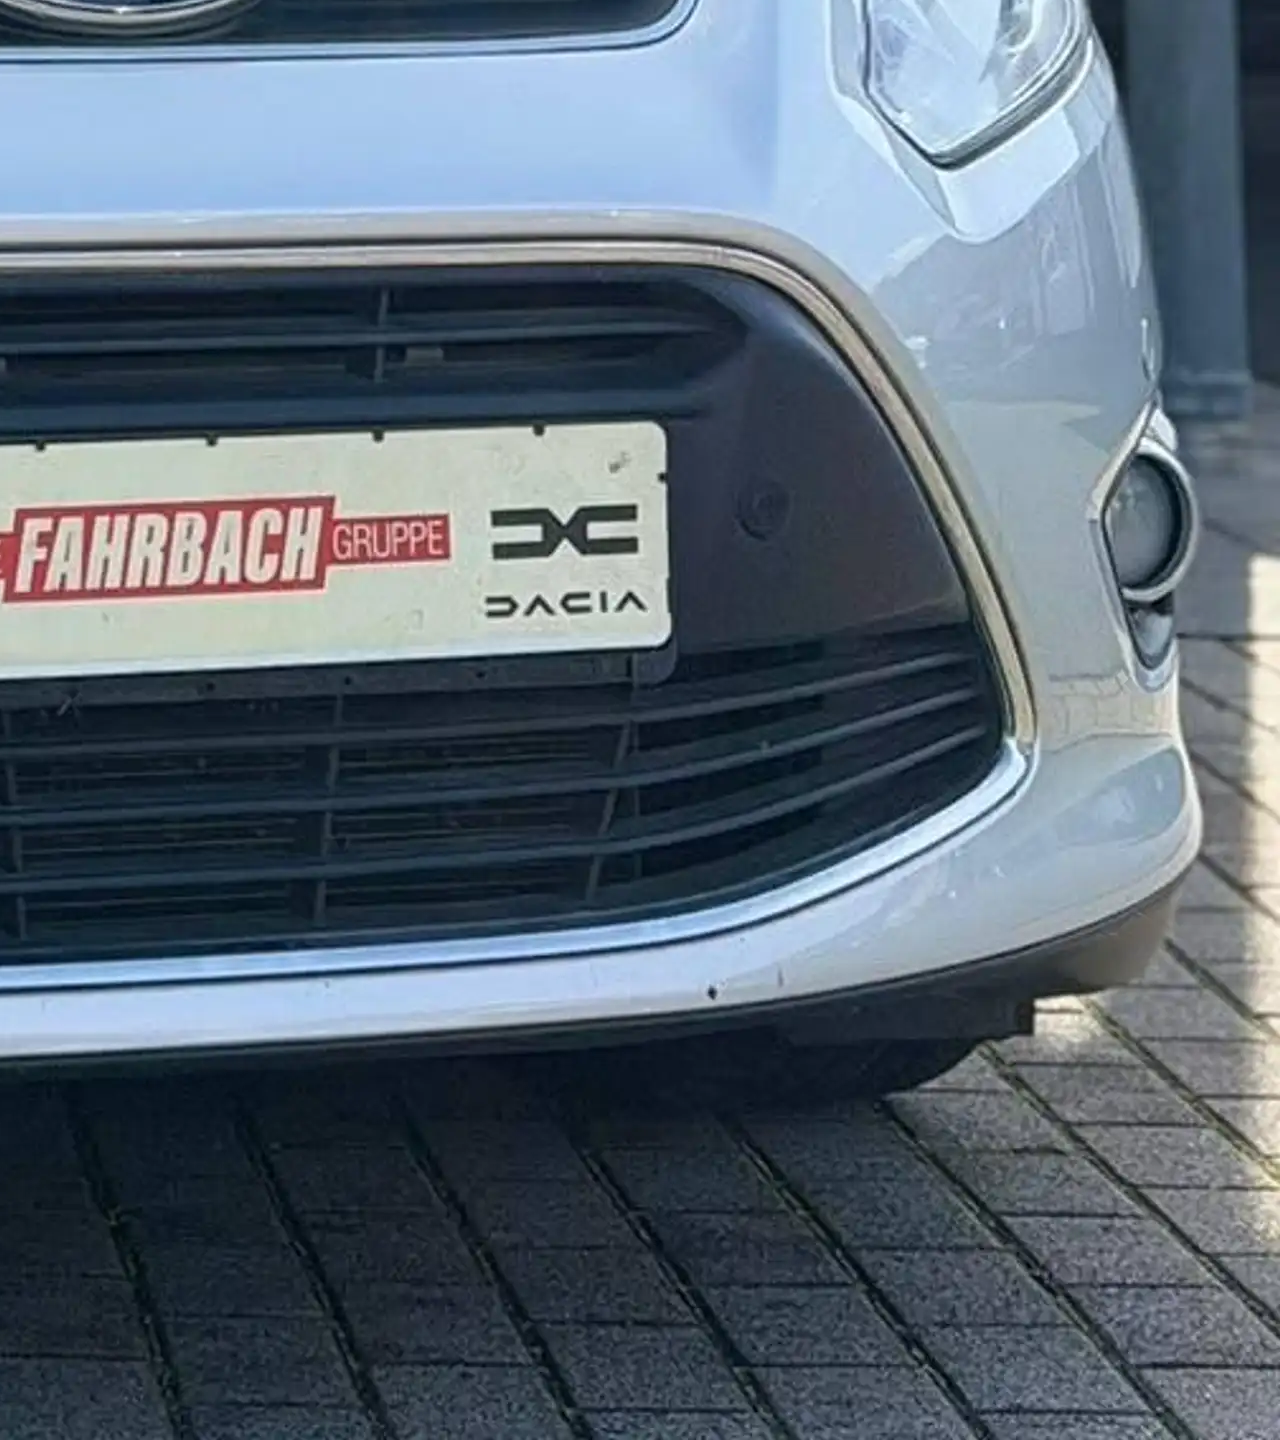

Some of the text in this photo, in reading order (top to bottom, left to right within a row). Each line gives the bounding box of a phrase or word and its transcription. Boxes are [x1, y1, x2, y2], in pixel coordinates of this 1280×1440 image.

[14, 507, 323, 593] FAHRBACH
[332, 520, 444, 559] GRUPPE
[485, 591, 647, 618] DACIA
